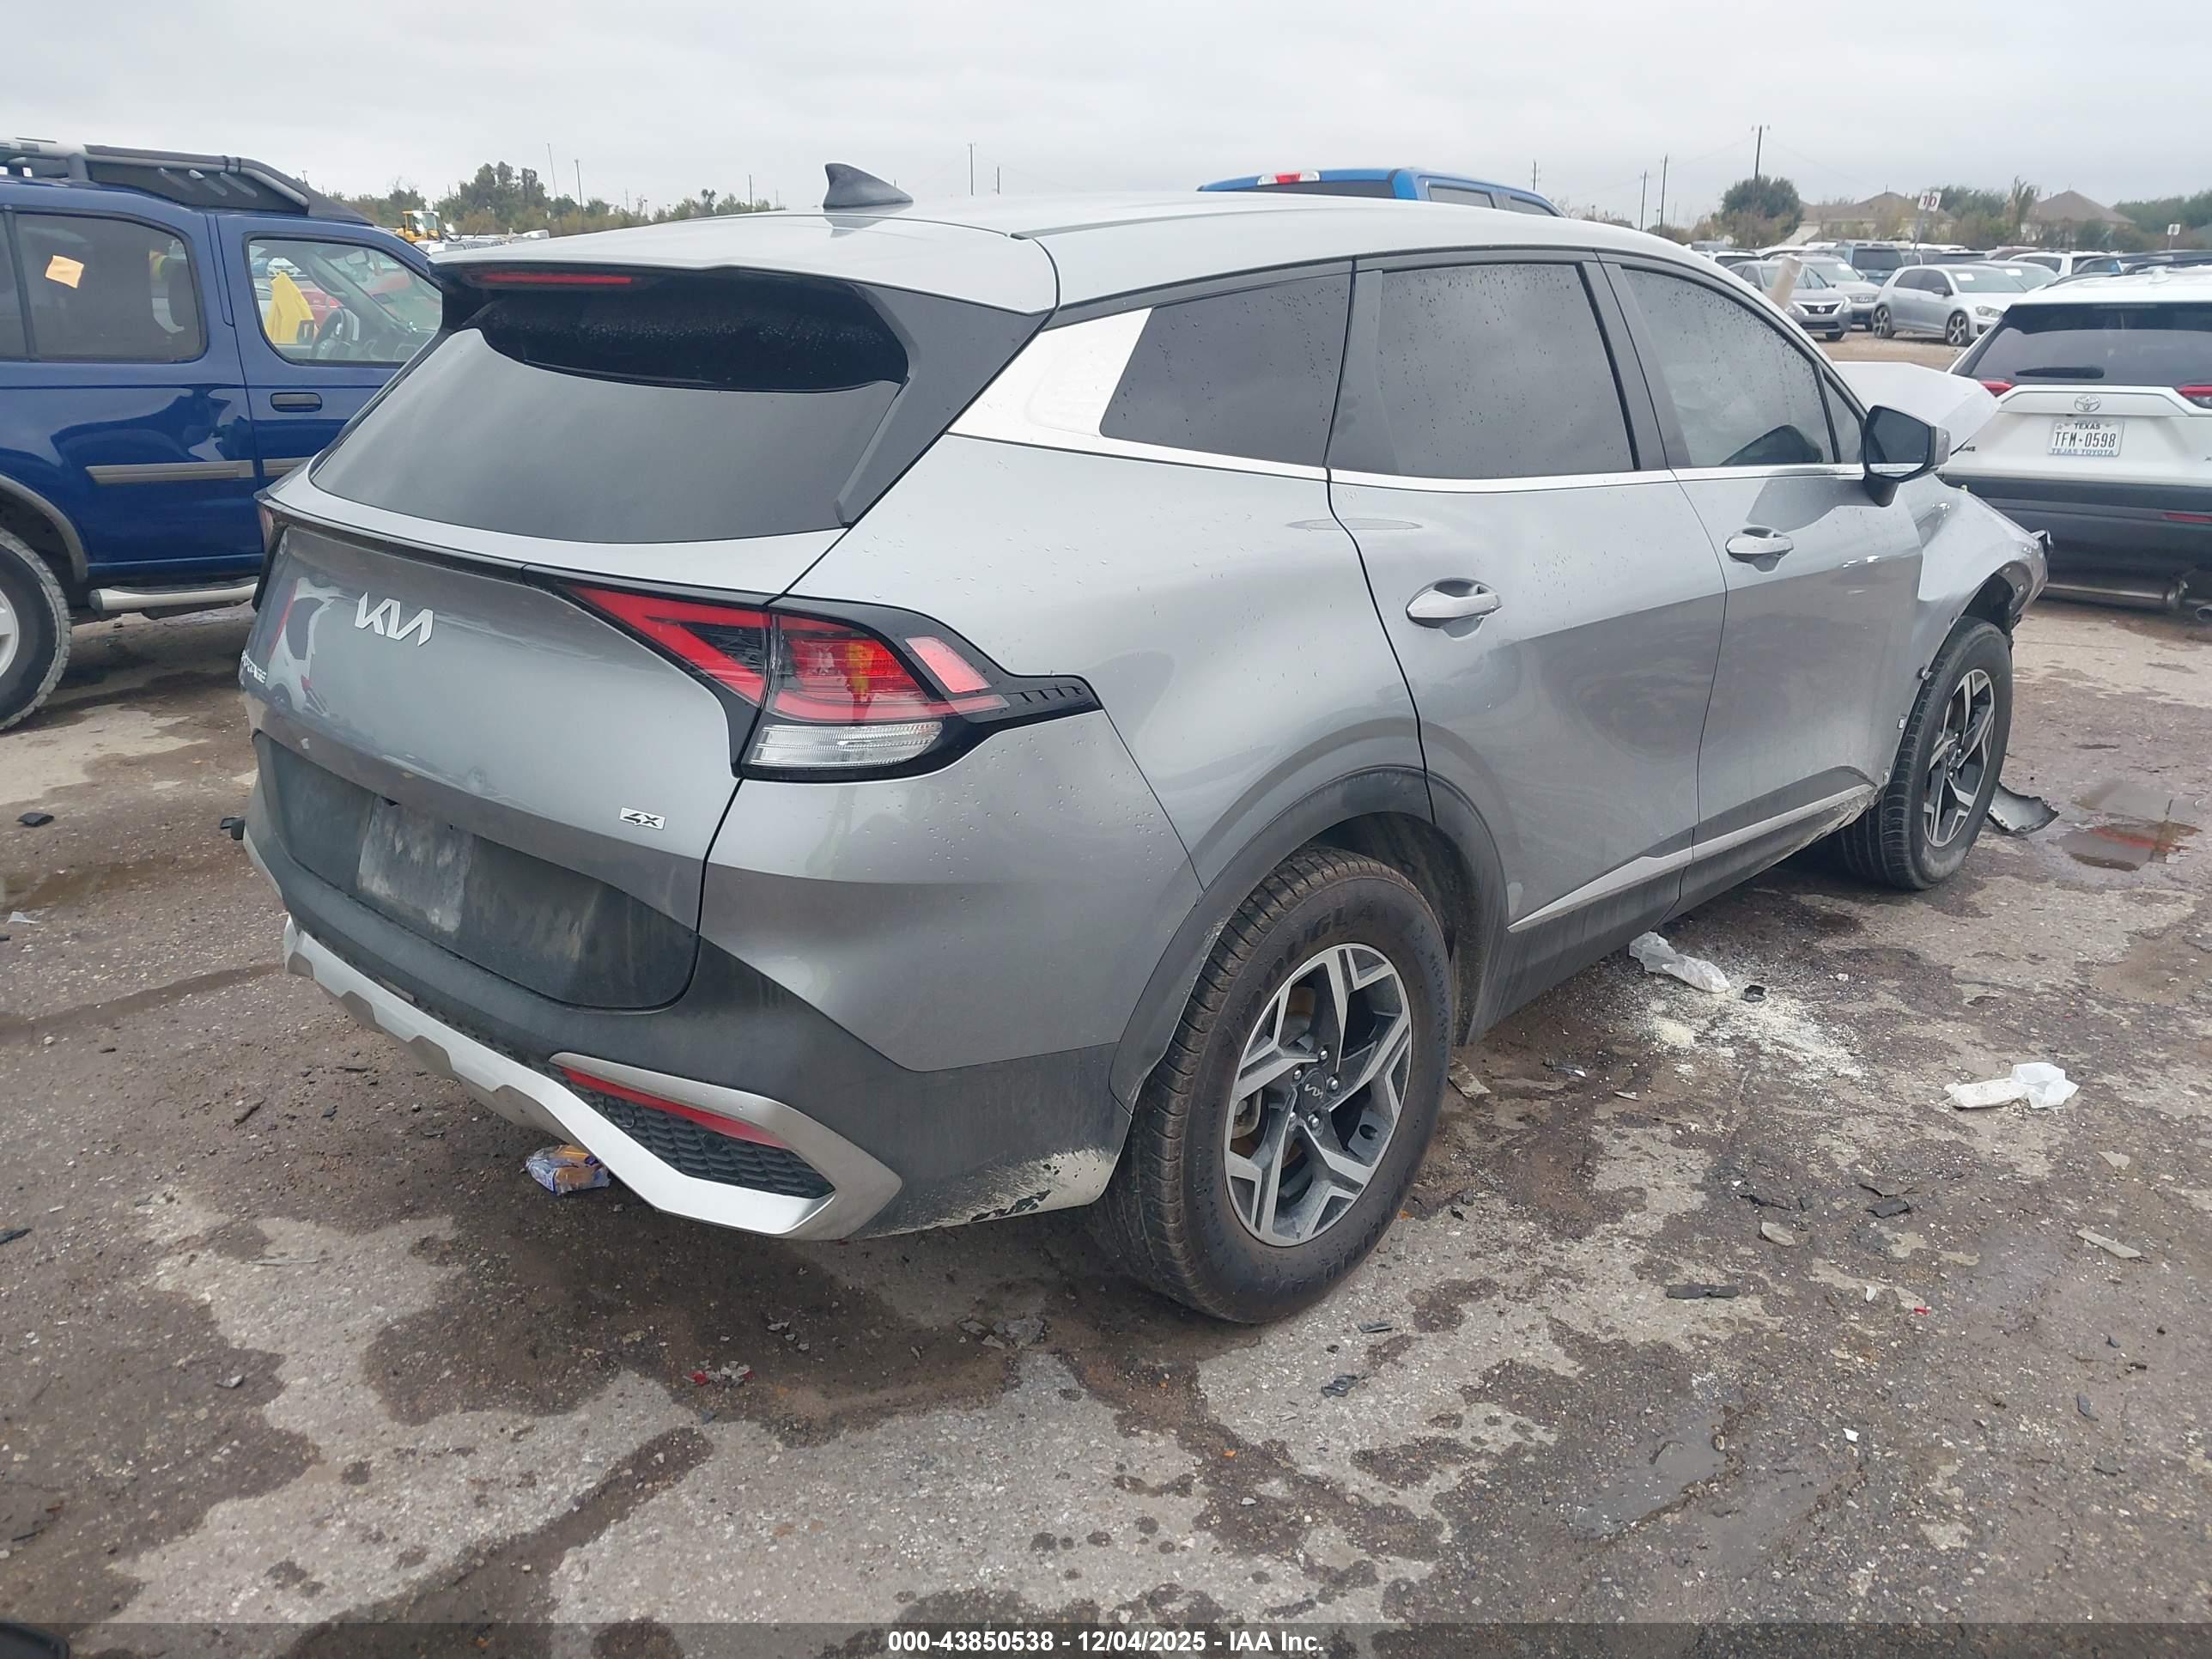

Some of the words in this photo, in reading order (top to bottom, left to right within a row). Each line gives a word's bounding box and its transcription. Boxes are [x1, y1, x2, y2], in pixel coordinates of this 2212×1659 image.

[1923, 195, 1938, 207] 10
[2074, 422, 2100, 430] TEXAS
[2081, 448, 2114, 457] TOYOTA
[355, 591, 434, 647] KIA
